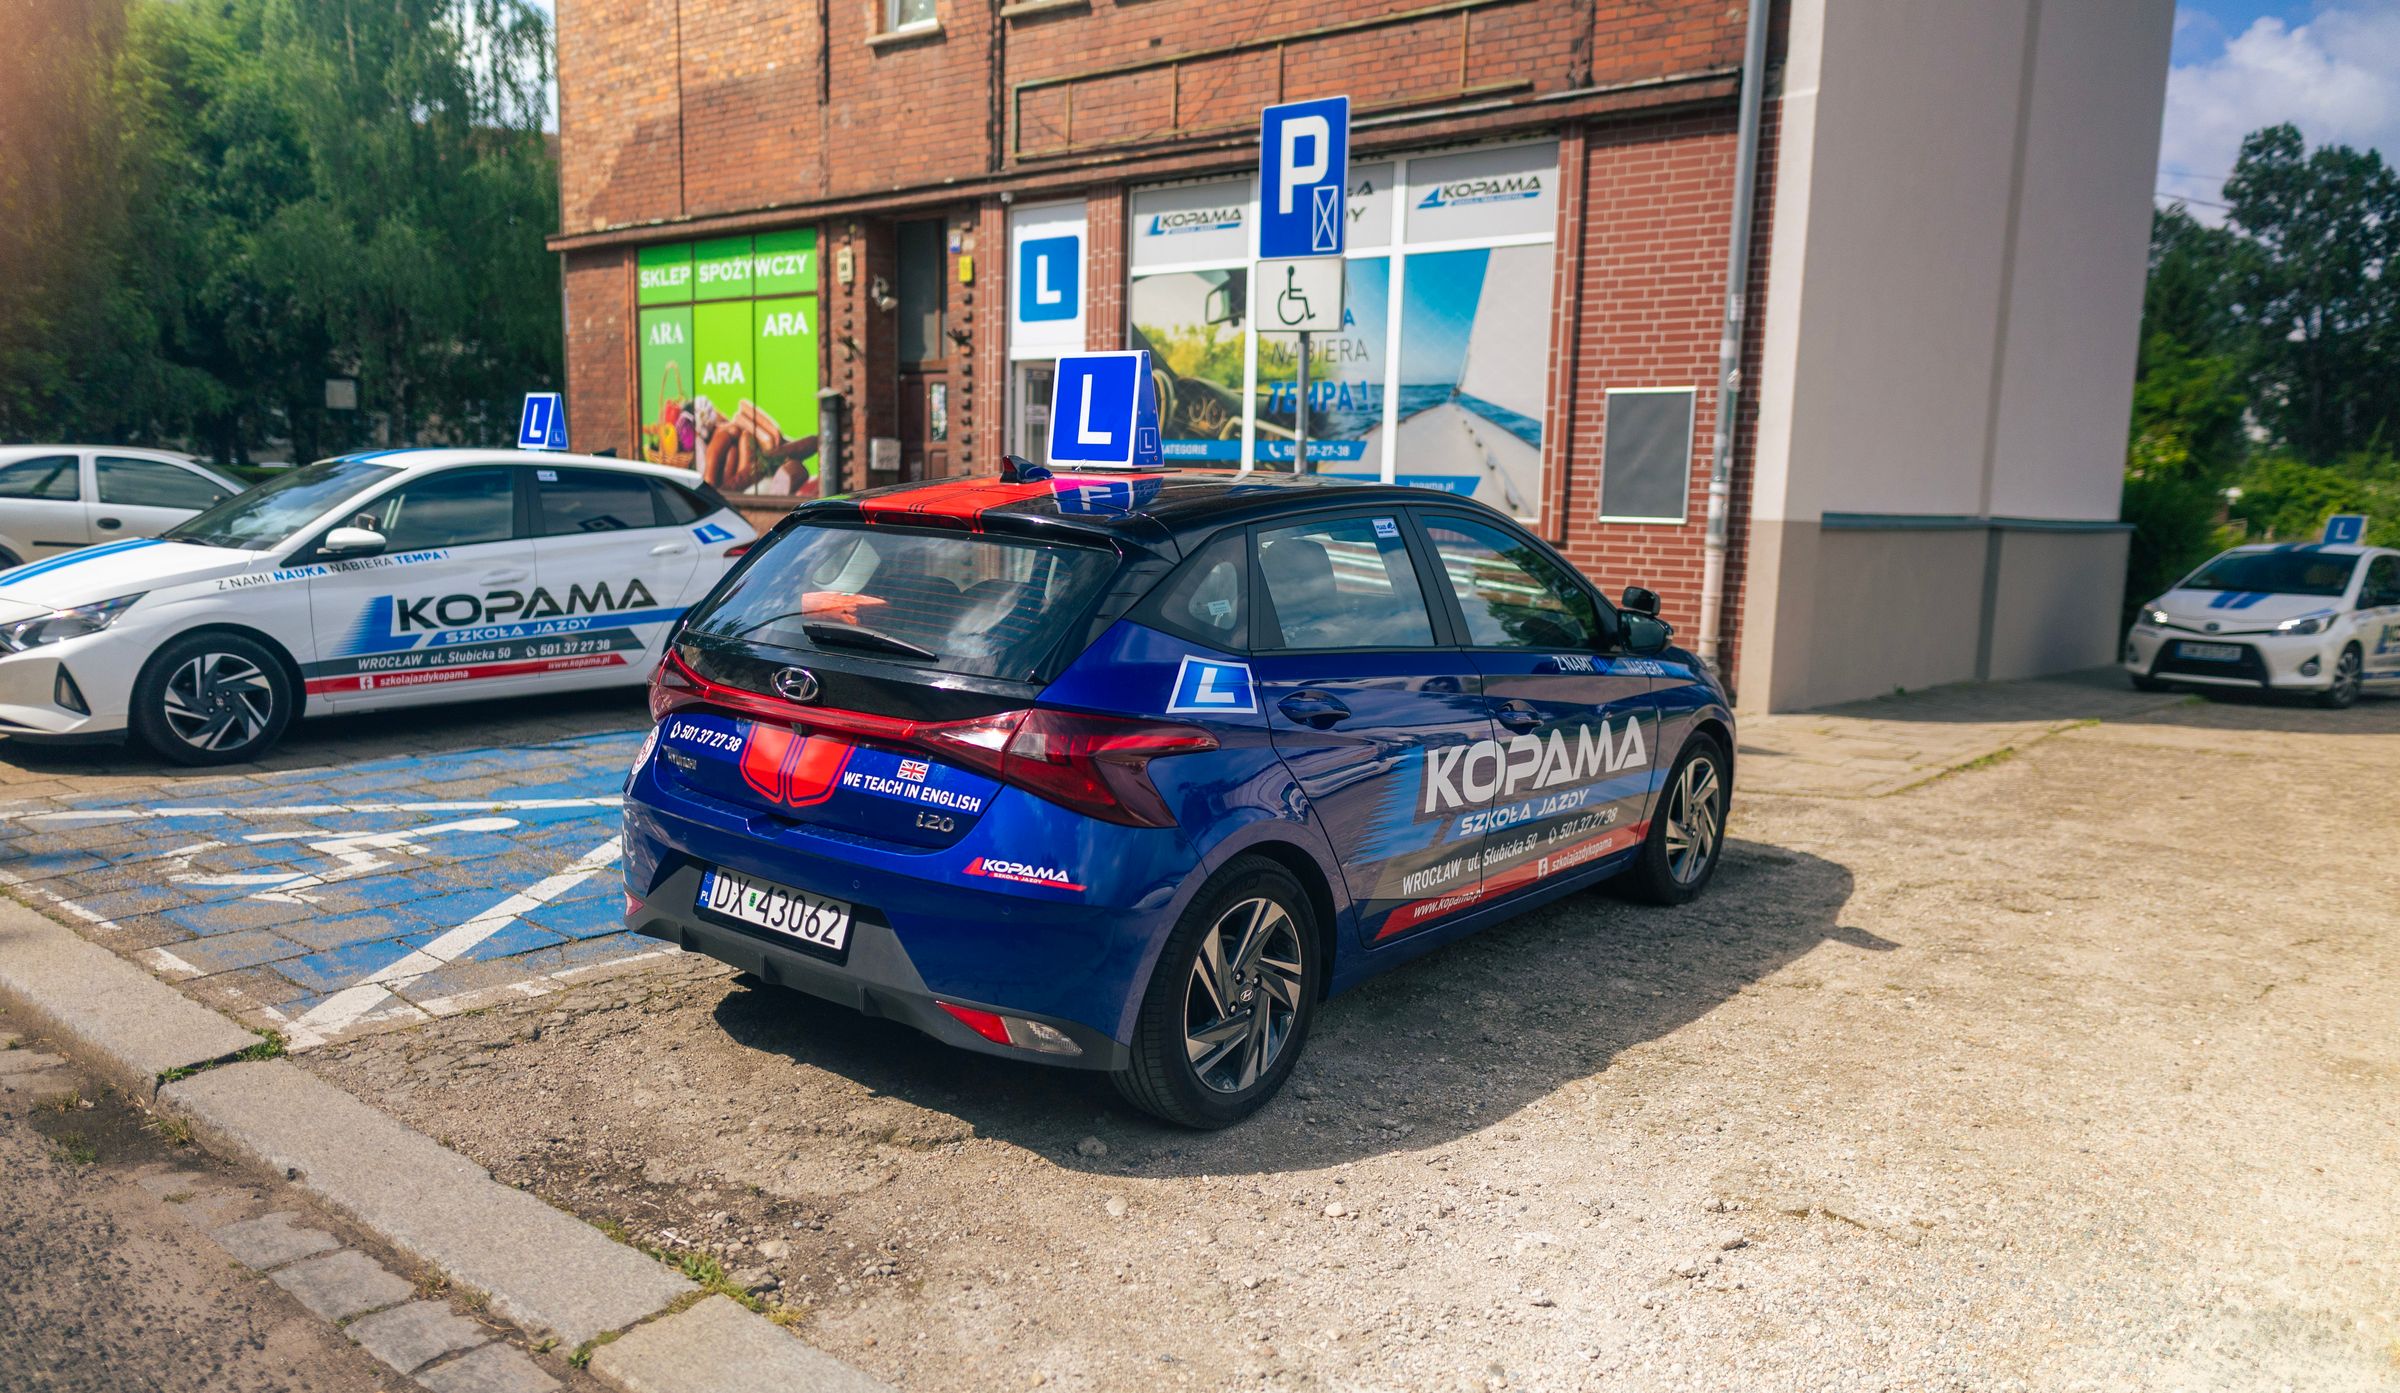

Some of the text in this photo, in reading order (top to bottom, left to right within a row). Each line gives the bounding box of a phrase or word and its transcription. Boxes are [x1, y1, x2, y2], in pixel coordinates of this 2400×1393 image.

[1279, 115, 1330, 214] P
[1442, 176, 1541, 198] KOPAMA
[1161, 208, 1242, 228] KOPAMA
[640, 254, 808, 288] SKLEP SPOŻYWCZY
[1036, 254, 1061, 304] L
[649, 321, 684, 345] ARA
[763, 311, 809, 337] ARA
[703, 361, 745, 384] ARA
[529, 403, 542, 438] L
[1077, 373, 1112, 445] L
[1162, 444, 1208, 455] ATEGORIE
[217, 580, 227, 590] Z
[229, 575, 271, 588] NAMI
[273, 565, 328, 582] NAUKA
[329, 558, 394, 574] NABIERA
[394, 552, 442, 565] TEMPA
[396, 578, 659, 632] KOPAMA
[445, 618, 592, 643] SZKOŁA JAZDY
[358, 647, 511, 671] WROCŁAW ul. Słubicka 50
[540, 639, 610, 656] 501 37 27 38
[1195, 667, 1236, 703] L
[680, 724, 743, 752] 501 37 27 38
[1424, 715, 1648, 814] KOPAMA
[843, 771, 981, 813] WE TEACH IN ENGLISH
[916, 811, 955, 833] i20
[1459, 788, 1590, 836] SZKOŁA JAZDY
[1558, 807, 1618, 838] 501 37 27 38
[982, 858, 1069, 883] KOPAMA
[1402, 832, 1538, 896] WROCŁAW ul. Słubicka 50
[700, 890, 709, 902] PL
[713, 871, 842, 946] DX 43062
